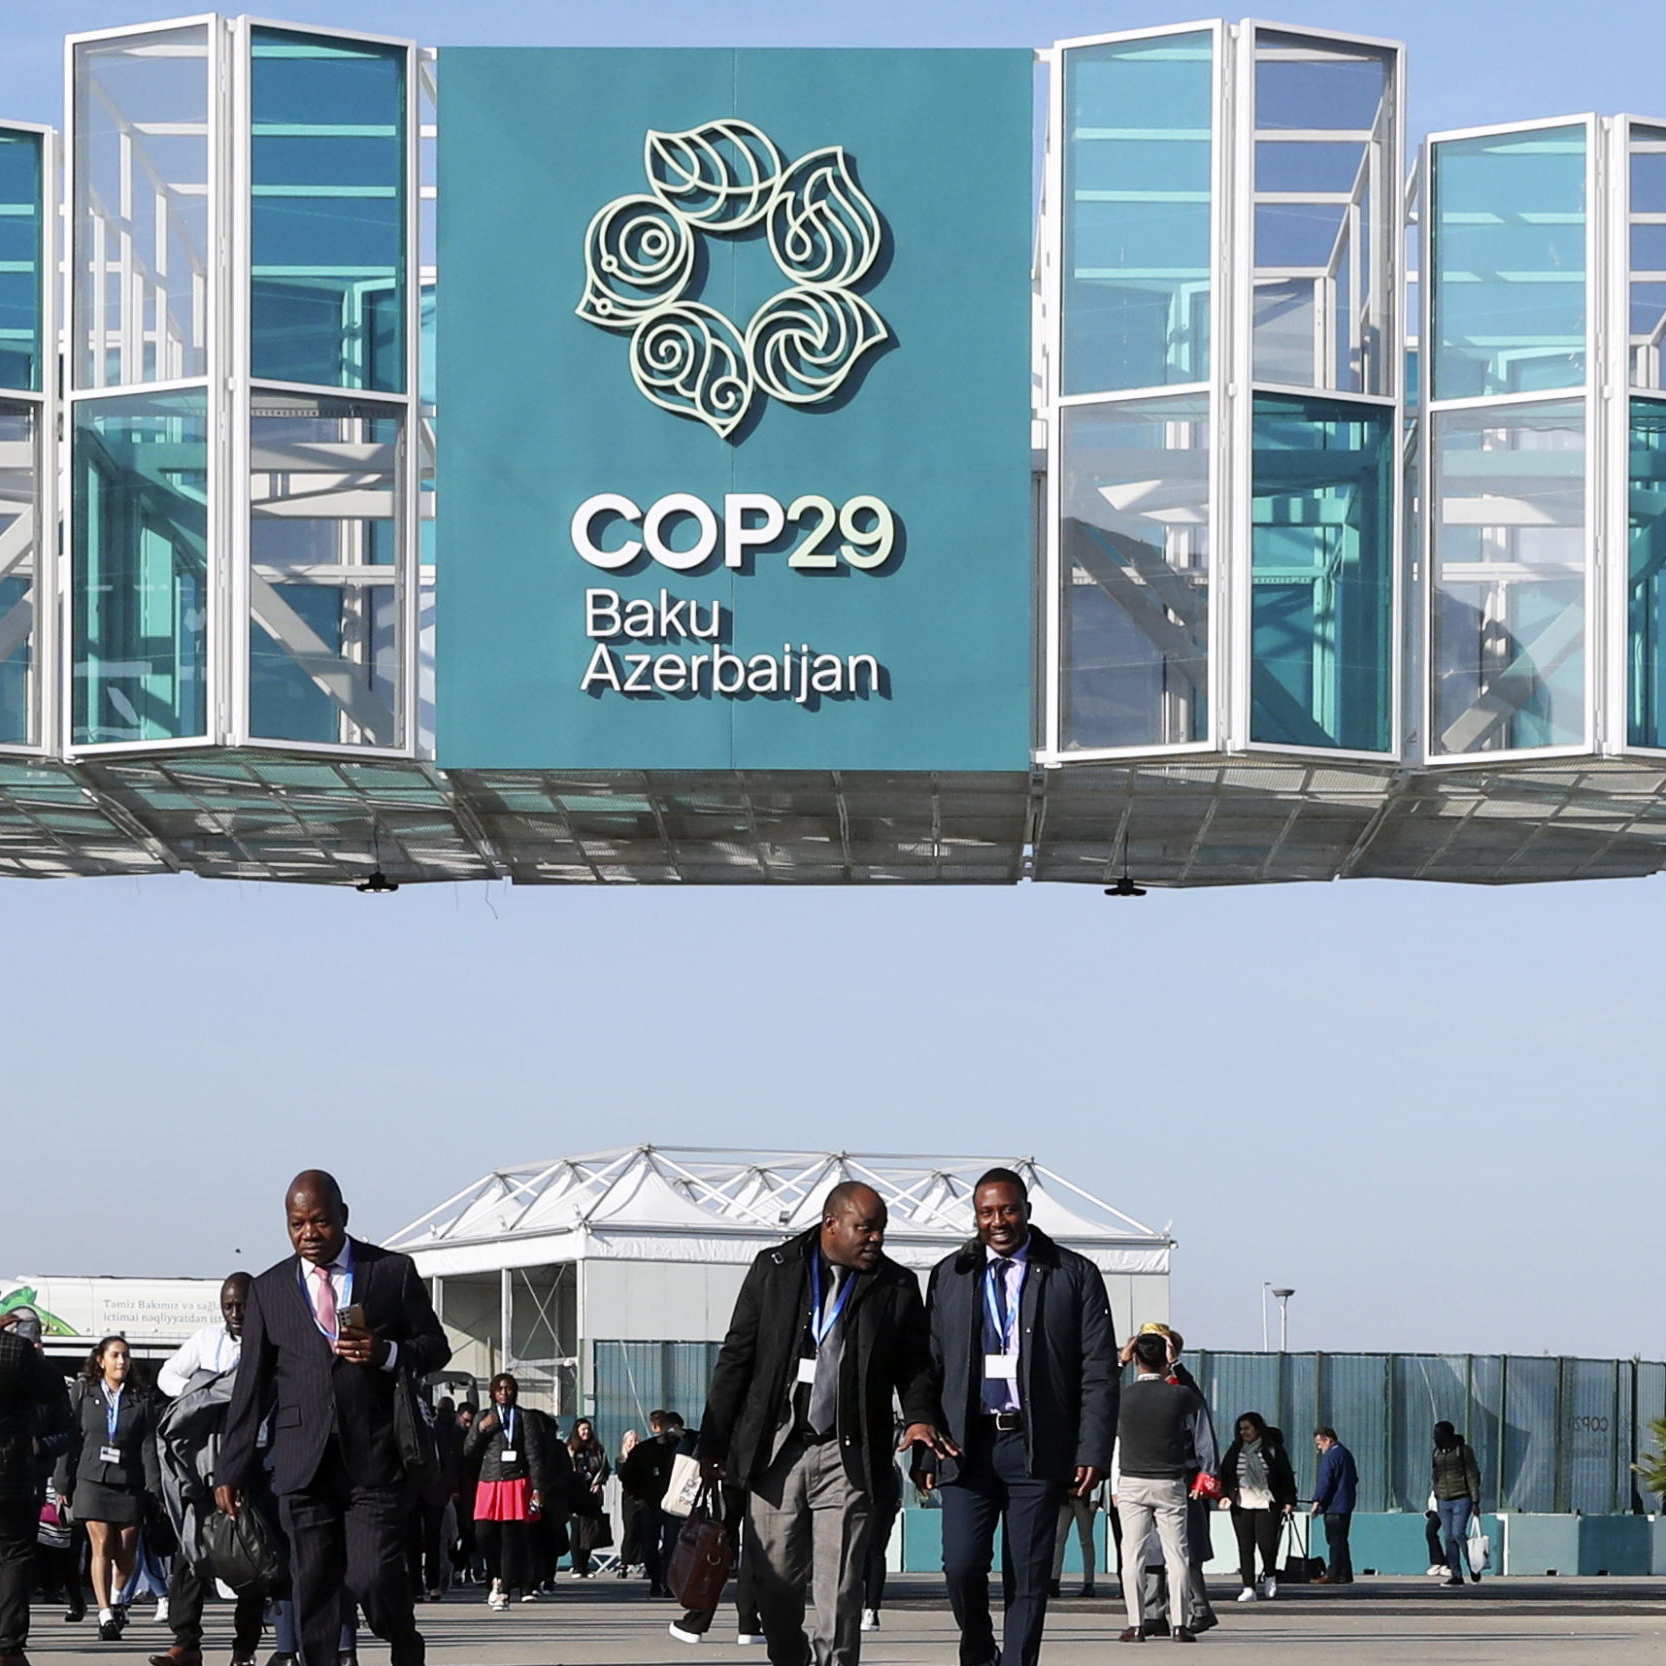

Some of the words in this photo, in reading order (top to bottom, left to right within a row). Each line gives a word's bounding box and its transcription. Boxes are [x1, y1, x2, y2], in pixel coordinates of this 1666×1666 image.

[571, 493, 895, 570] COP29
[585, 588, 720, 638] Baku
[581, 643, 879, 703] Azerbaijan
